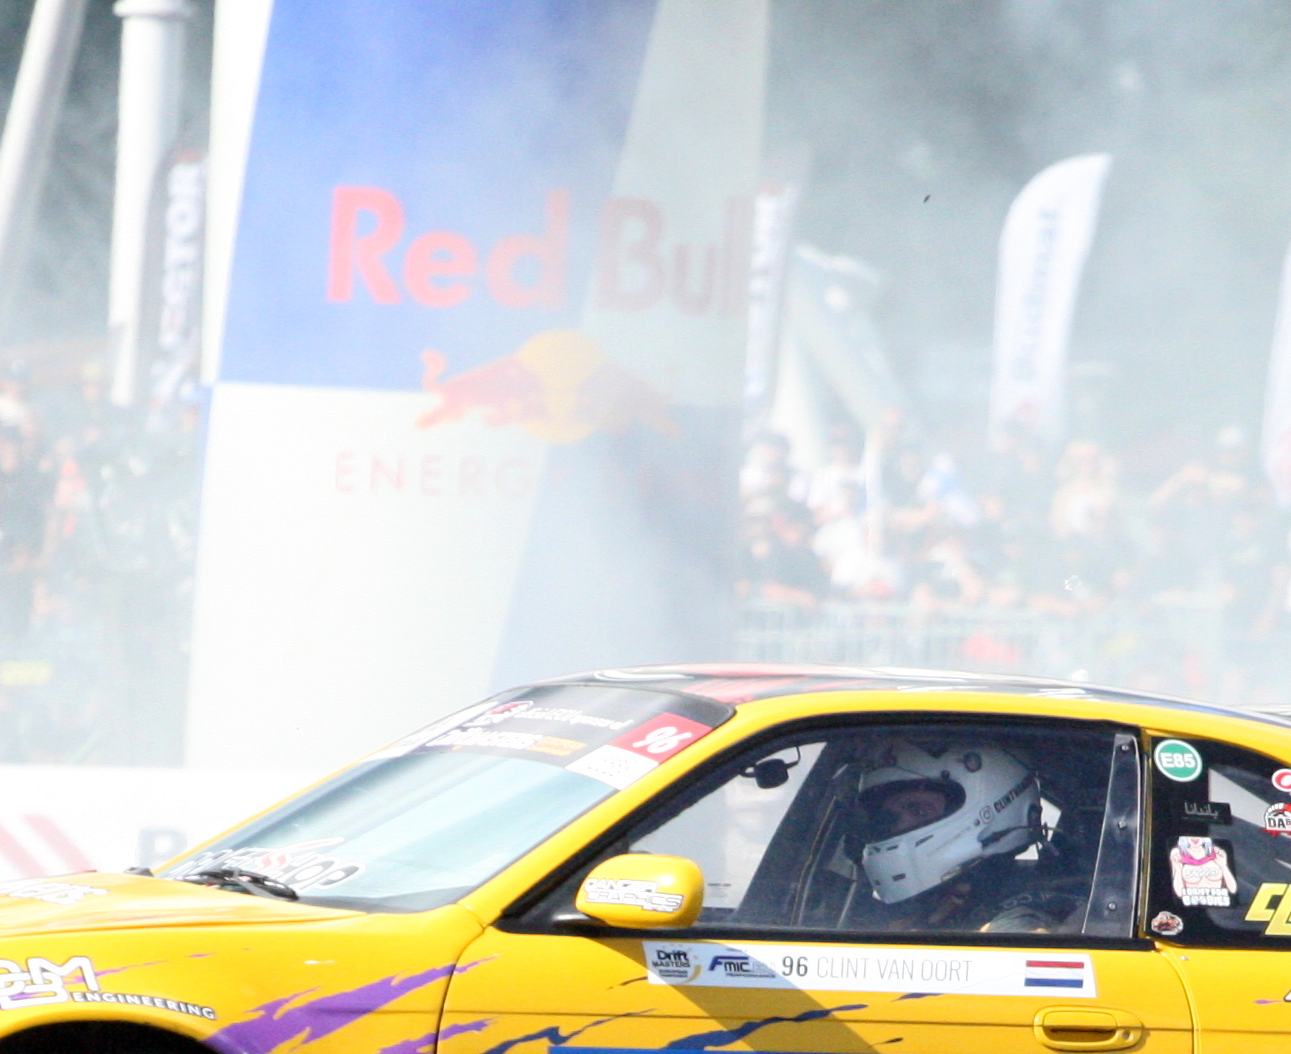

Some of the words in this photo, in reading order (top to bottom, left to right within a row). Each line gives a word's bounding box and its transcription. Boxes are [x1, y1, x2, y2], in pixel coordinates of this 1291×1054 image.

[325, 184, 572, 309] Red
[334, 450, 537, 500] ENERG
[1160, 751, 1196, 770] E85
[656, 950, 688, 961] Drift
[782, 955, 808, 977] 96
[817, 956, 869, 979] CLINT
[877, 958, 914, 980] VAN
[921, 959, 973, 982] OORT
[73, 991, 217, 1020] ENGINEERING
